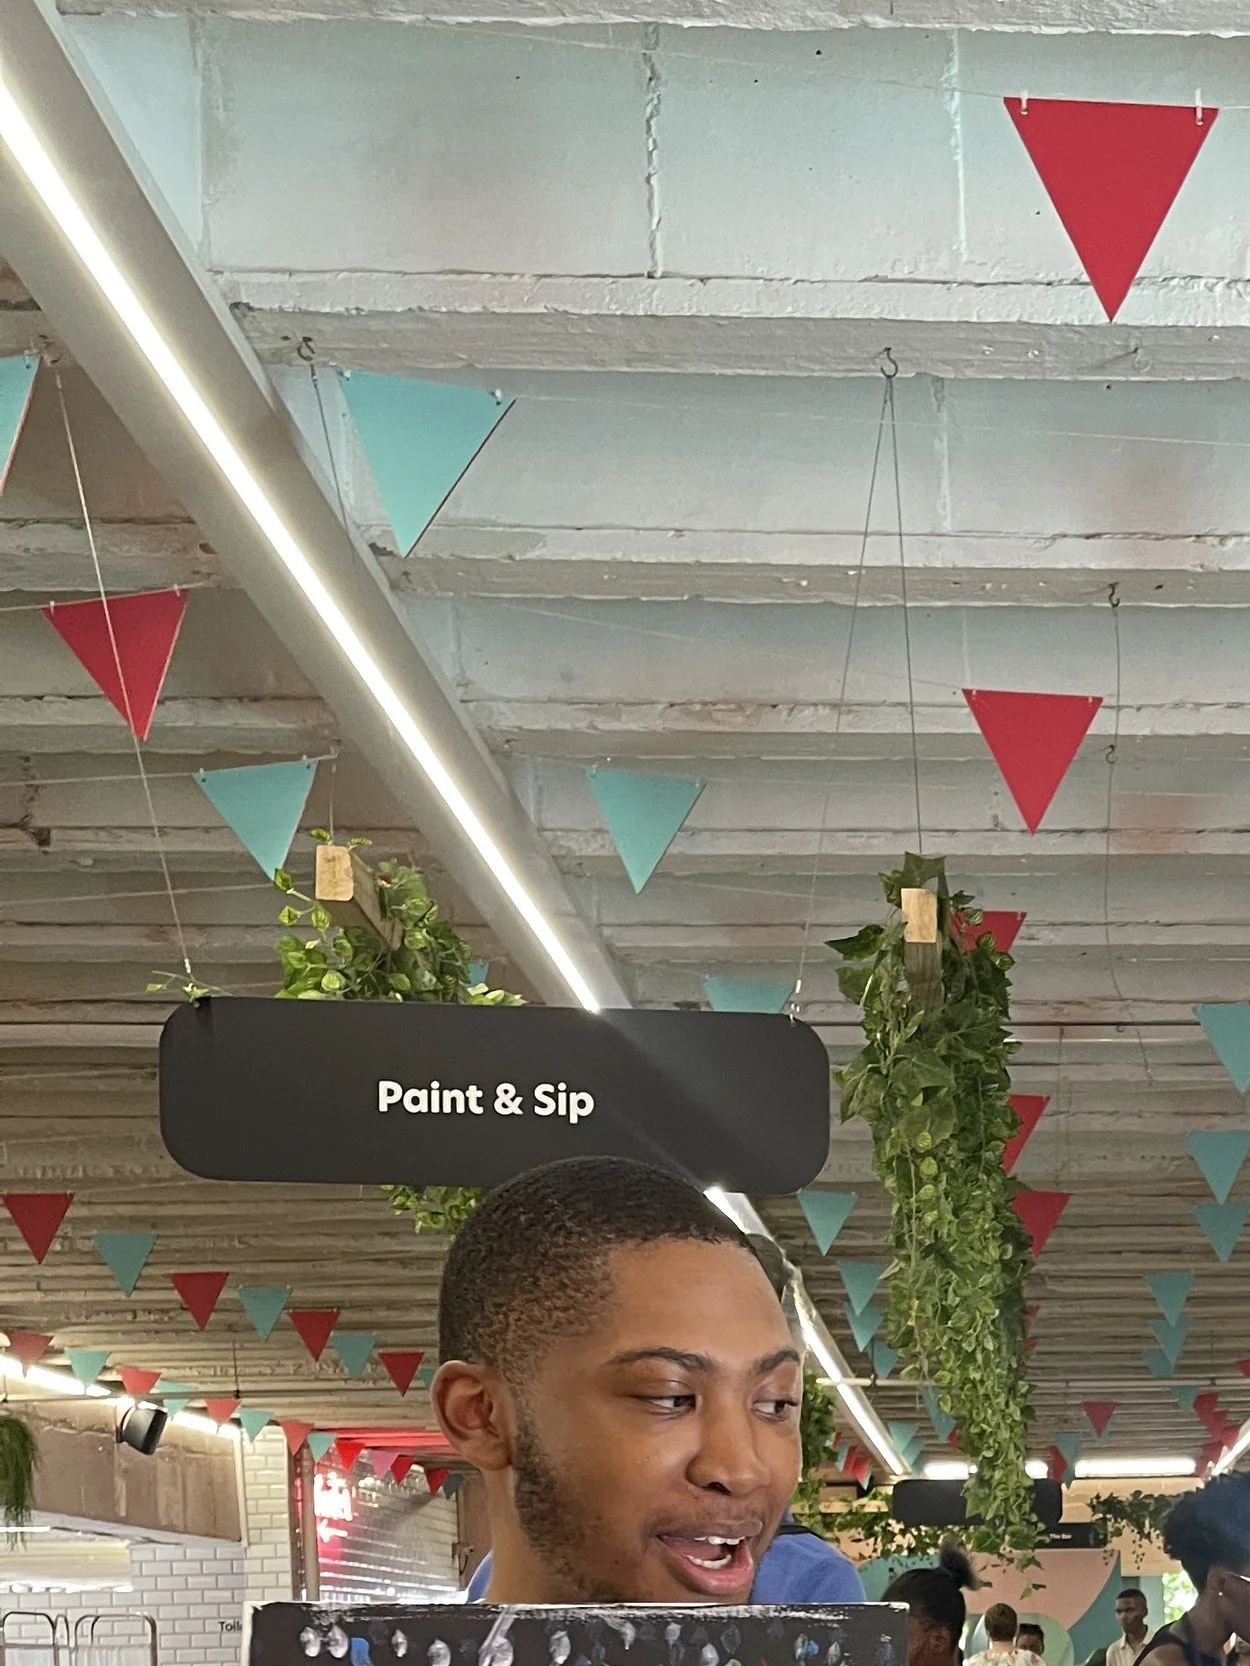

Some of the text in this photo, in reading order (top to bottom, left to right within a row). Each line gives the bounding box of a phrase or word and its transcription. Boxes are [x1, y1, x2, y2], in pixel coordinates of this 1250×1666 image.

[378, 1080, 595, 1124] Paint & Sip
